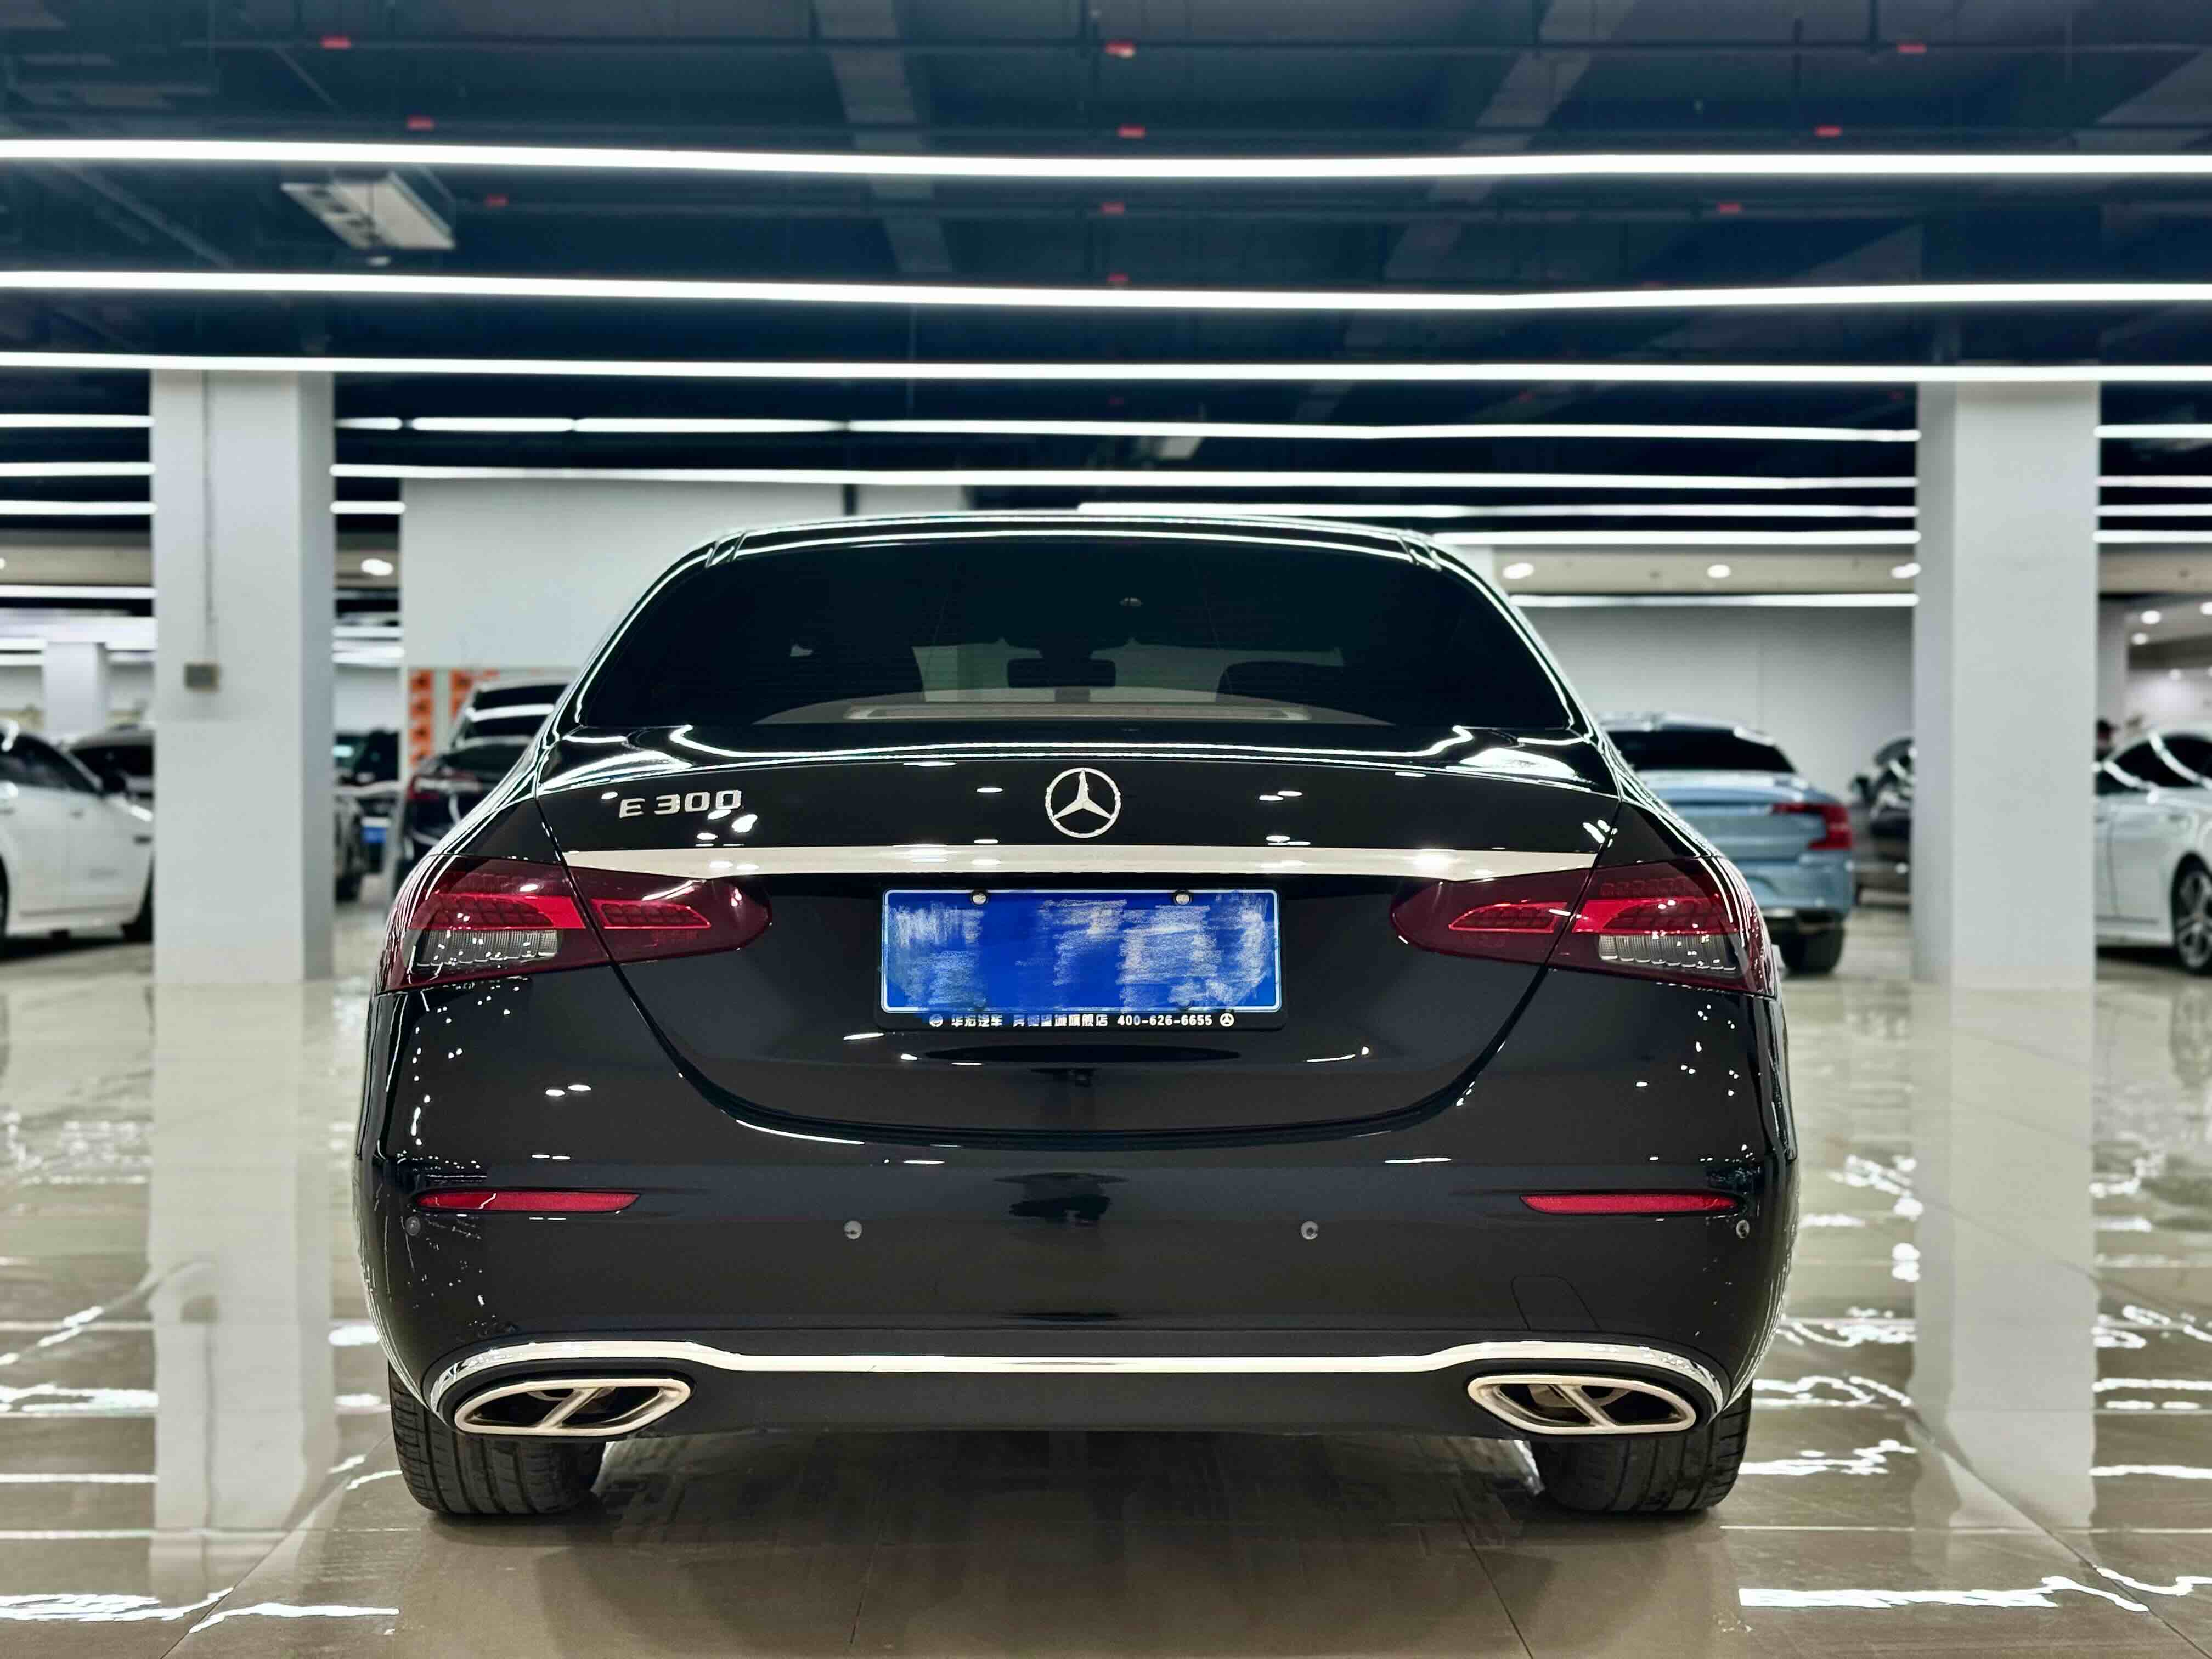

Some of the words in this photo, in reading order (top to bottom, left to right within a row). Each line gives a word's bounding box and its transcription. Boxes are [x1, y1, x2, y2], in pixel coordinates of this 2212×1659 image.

[619, 798, 645, 819] E
[654, 789, 742, 815] 300
[1117, 1015, 1212, 1026] 400-626-6655
